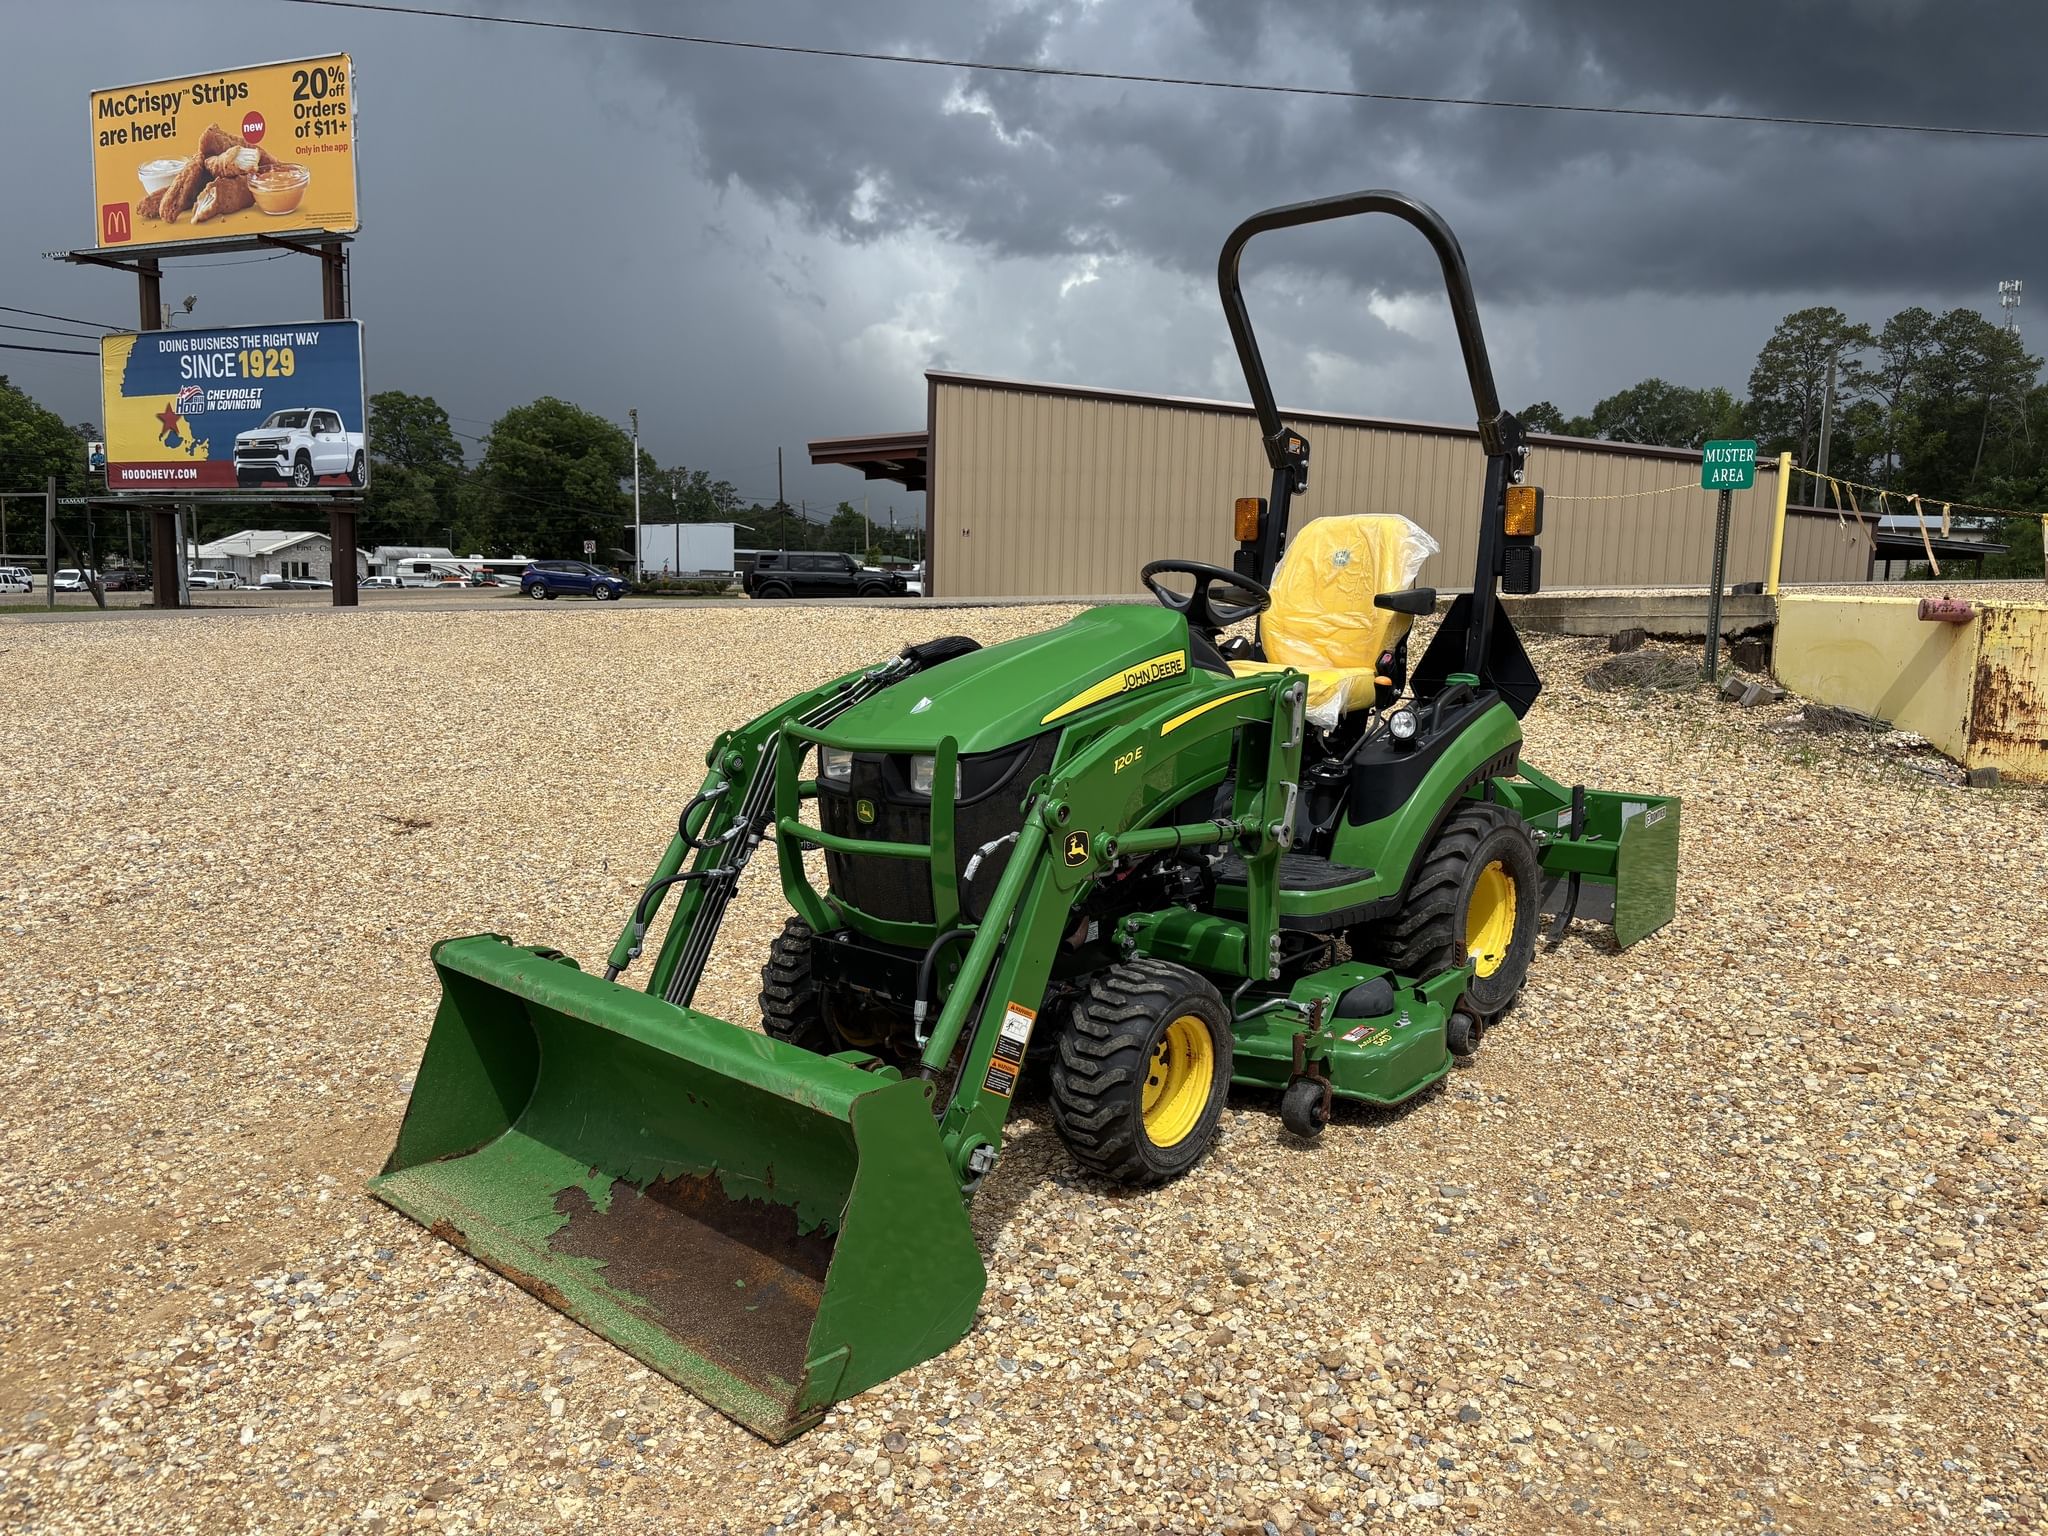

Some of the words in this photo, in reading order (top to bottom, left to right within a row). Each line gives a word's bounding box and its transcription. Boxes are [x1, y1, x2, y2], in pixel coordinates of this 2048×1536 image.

[192, 78, 249, 107] Strips
[292, 66, 345, 101] 20%
[329, 84, 345, 97] off
[294, 101, 347, 119] Orders
[99, 128, 128, 147] are
[131, 117, 177, 143] here!
[243, 122, 263, 133] new
[295, 121, 311, 138] of
[314, 118, 347, 139] $11+
[295, 145, 313, 156] Only
[313, 144, 321, 153] in
[321, 143, 334, 153] the
[334, 143, 348, 152] app
[159, 339, 189, 353] DOING
[191, 336, 239, 351] BUISNESS
[240, 334, 261, 348] THE
[263, 333, 294, 347] RIGHT
[295, 332, 319, 346] WAY
[180, 352, 237, 379] SINCE
[238, 347, 295, 379] 1929
[206, 387, 263, 401] CHEVROLET
[206, 400, 216, 411] IN
[217, 399, 262, 411] COVINGTON
[1704, 448, 1754, 463] MUSTER
[121, 468, 197, 480] HOODCHEVY.COM
[1711, 467, 1744, 483] AREA
[1123, 670, 1151, 690] JOHN
[1150, 659, 1183, 679] DEERE
